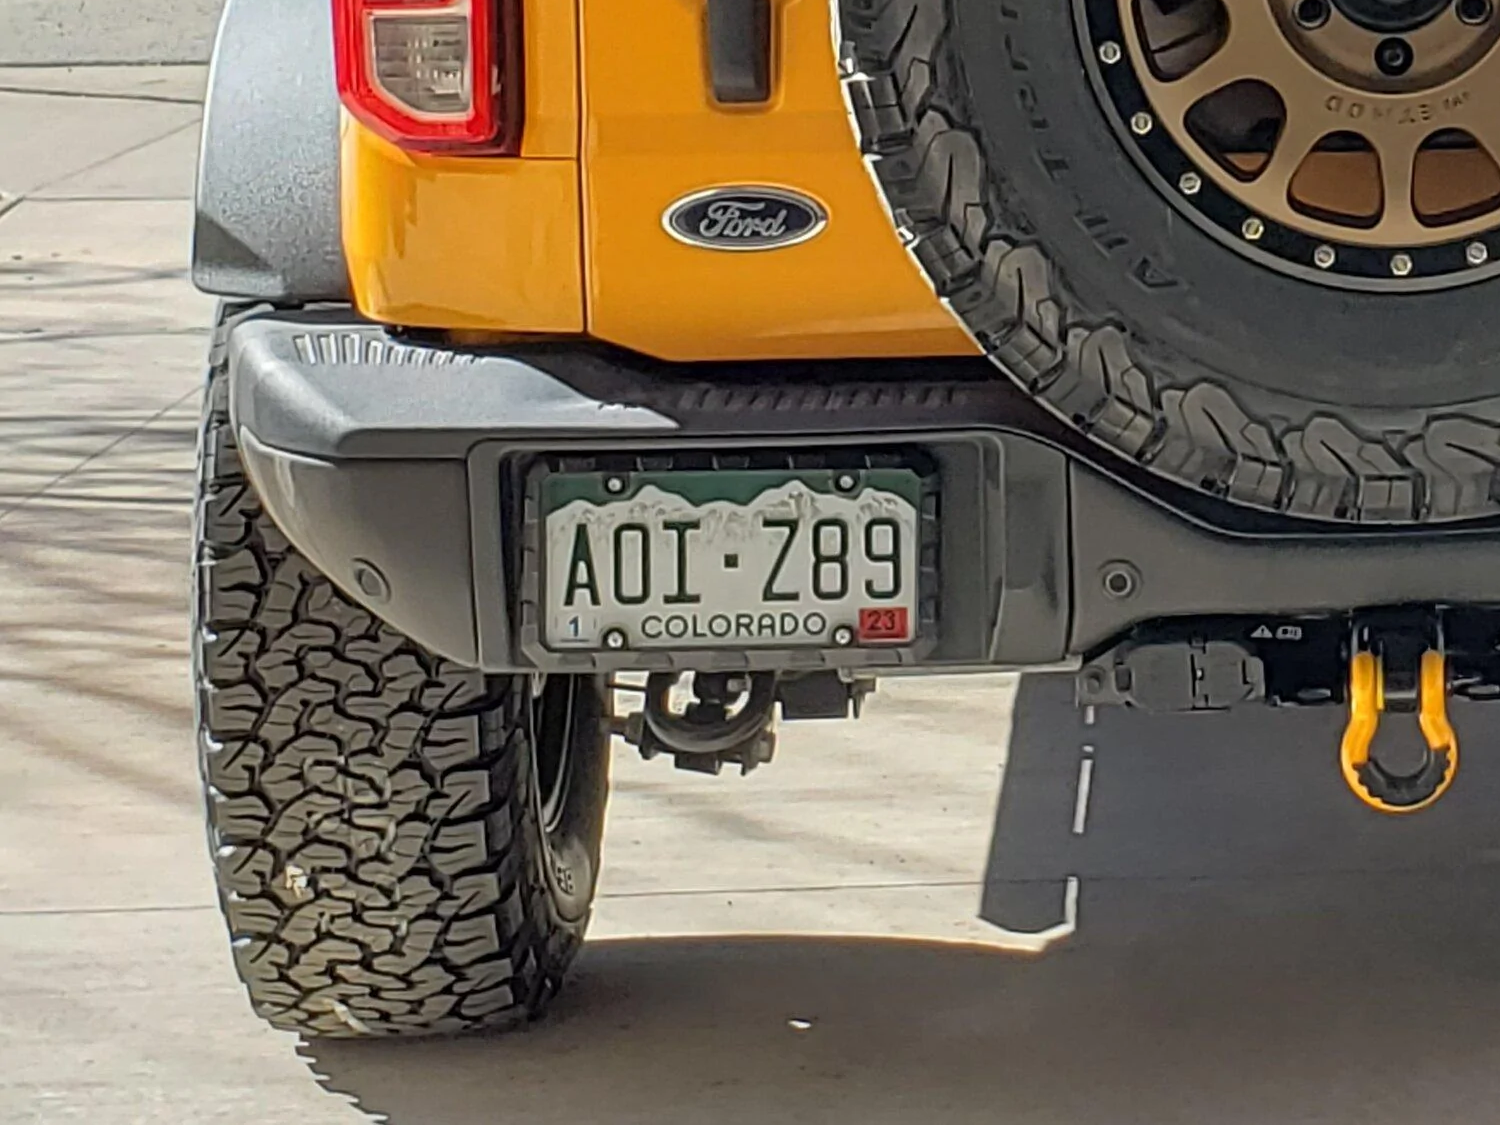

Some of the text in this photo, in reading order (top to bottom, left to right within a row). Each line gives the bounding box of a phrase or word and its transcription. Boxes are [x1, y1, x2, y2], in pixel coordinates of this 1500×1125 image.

[699, 201, 788, 237] Ford
[567, 610, 897, 638] 1 COLORADO 23
